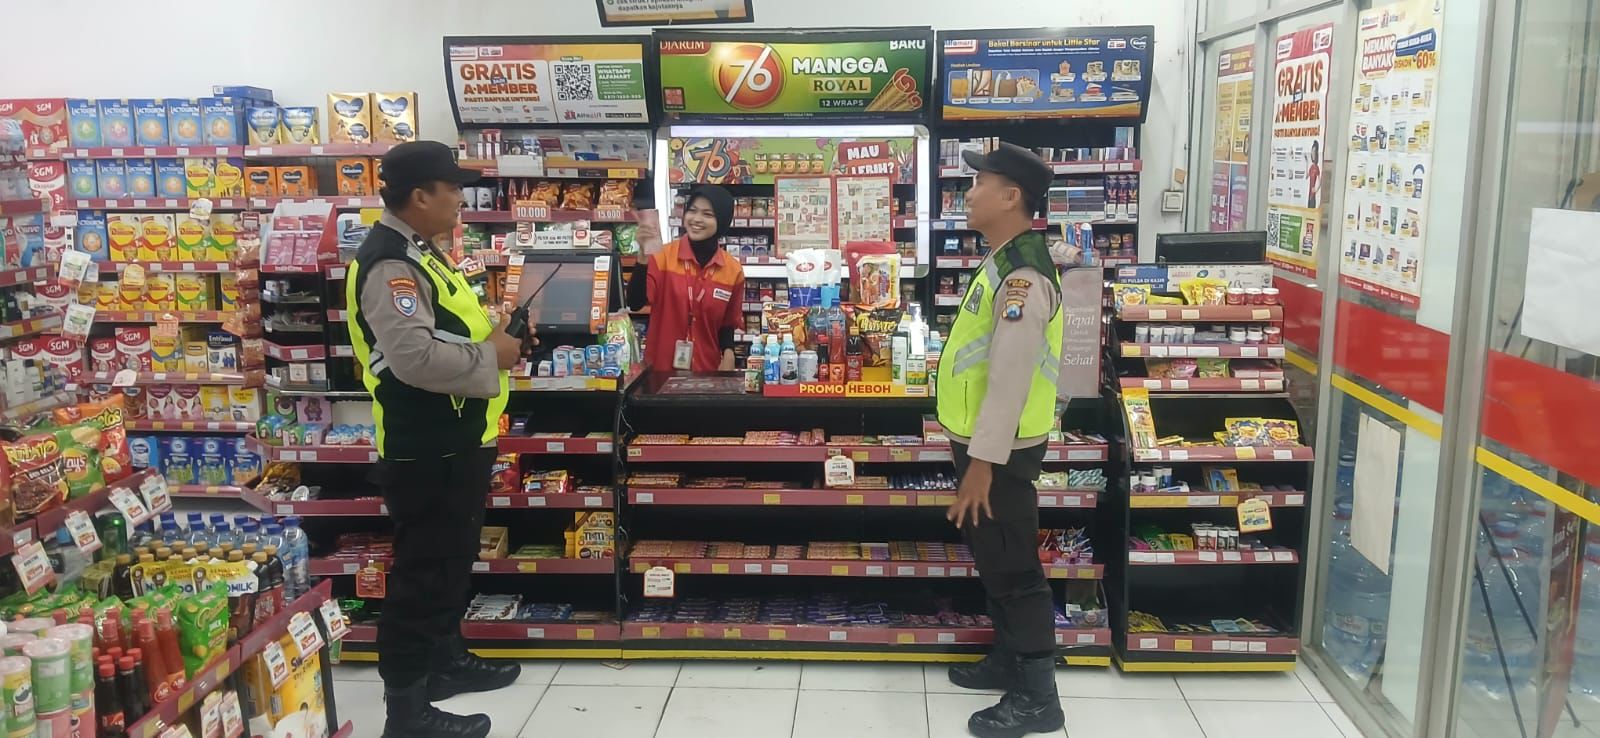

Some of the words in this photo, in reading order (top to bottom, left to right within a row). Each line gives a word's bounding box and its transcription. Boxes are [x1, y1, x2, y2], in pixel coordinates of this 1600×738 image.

[660, 41, 705, 51] DJARUM
[889, 40, 926, 50] BARU
[1364, 35, 1395, 55] MENANG
[791, 57, 889, 75] MANGGA
[1362, 51, 1394, 71] BANYAK
[460, 63, 537, 80] GRATIS
[724, 44, 773, 103] 76
[1278, 60, 1324, 97] GRATIS
[813, 79, 869, 92] ROYAL
[36, 102, 52, 112] SGM
[833, 99, 864, 107] WRAPS
[847, 144, 880, 161] MAU
[689, 137, 731, 184] 76
[34, 165, 53, 177] SGM
[54, 194, 64, 203] 3+
[516, 206, 547, 218] 10.000
[45, 284, 62, 294] SGM
[1066, 313, 1095, 329] Tepat
[123, 332, 141, 342] SGM
[18, 343, 34, 352] SGM
[50, 340, 70, 351] SGM
[142, 357, 150, 366] 5+
[1063, 353, 1094, 366] Sehat
[71, 367, 81, 377] 5+
[799, 384, 845, 394] PROMO
[848, 384, 891, 394] HEBOH
[206, 582, 253, 593] INMILK
